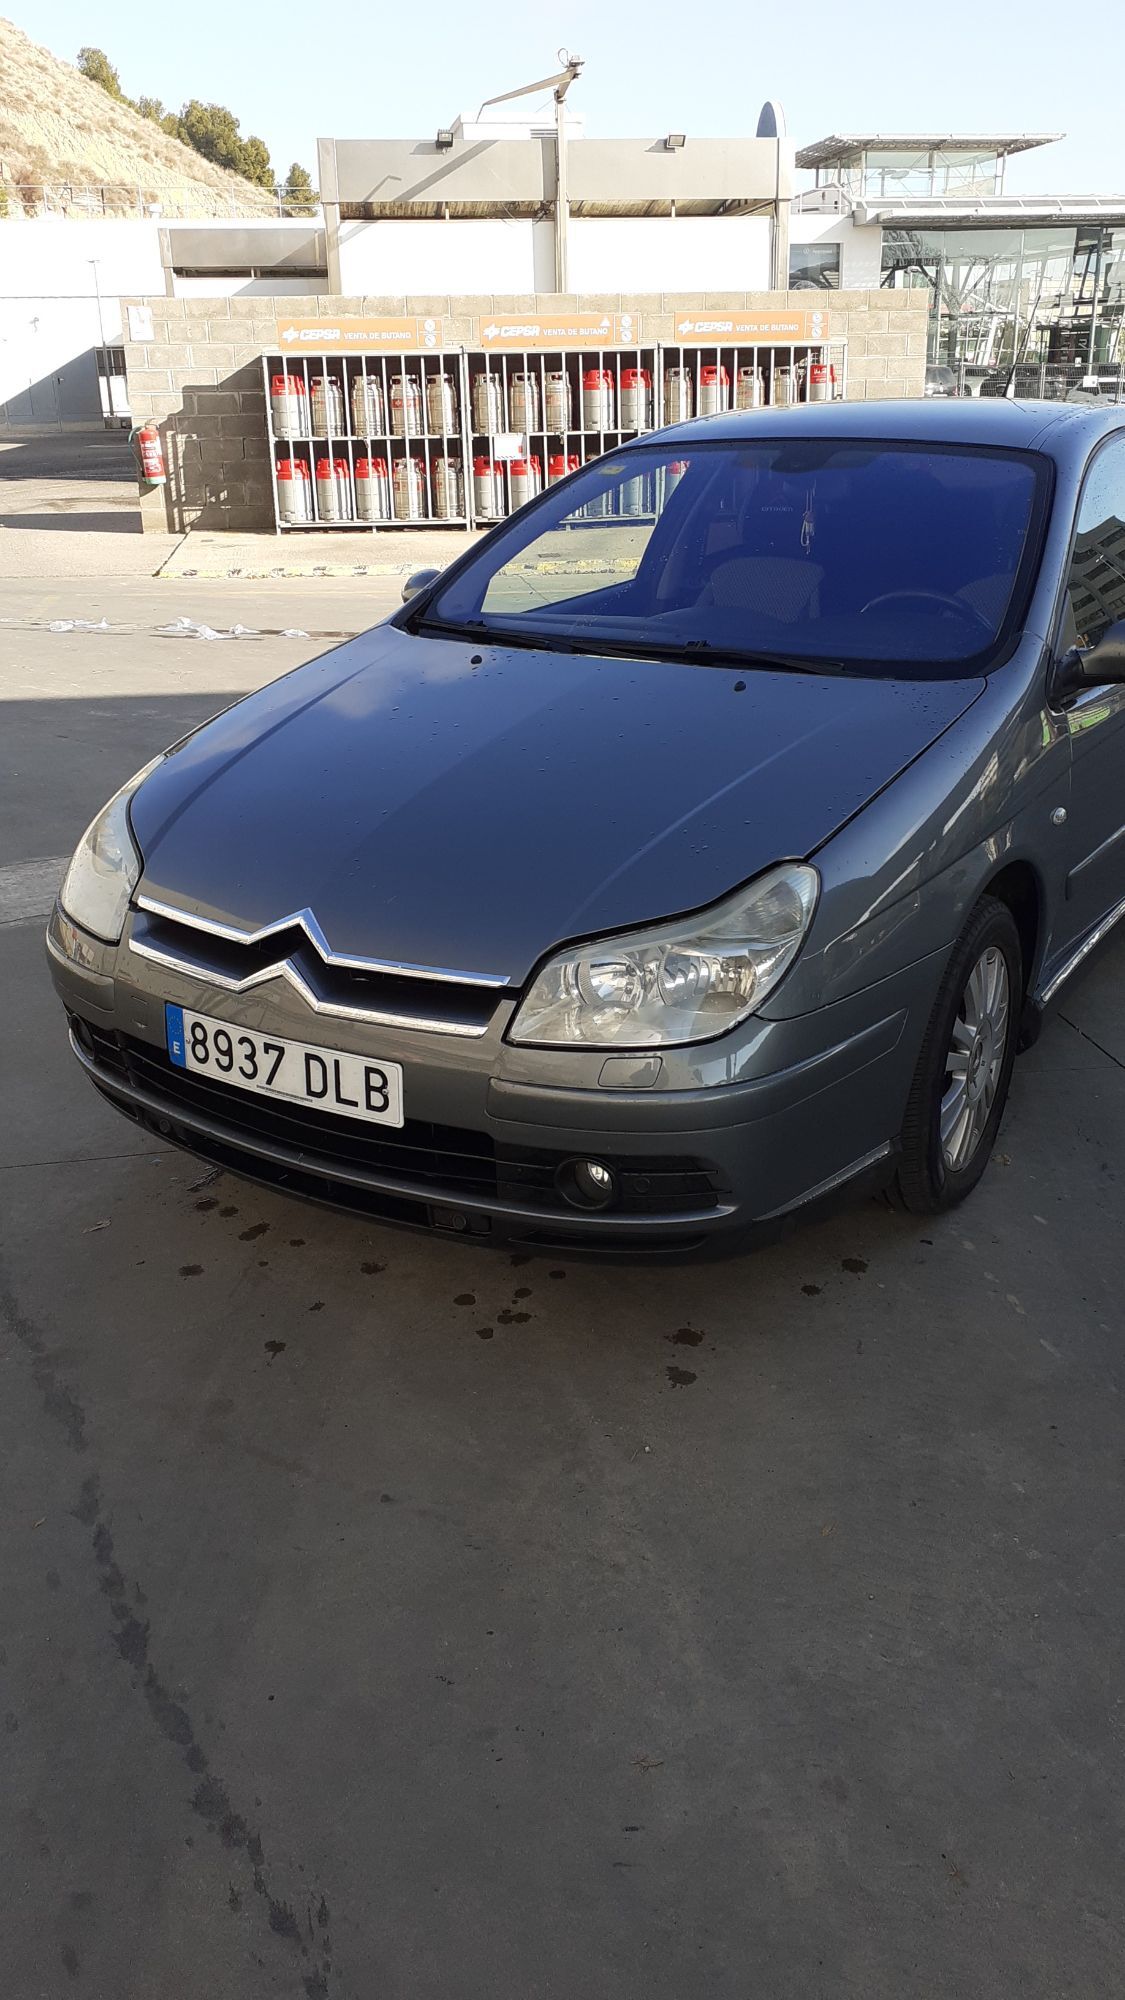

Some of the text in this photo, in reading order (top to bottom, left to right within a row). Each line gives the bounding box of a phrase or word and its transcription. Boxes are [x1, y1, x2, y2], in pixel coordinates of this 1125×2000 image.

[500, 325, 608, 337] CEPSA VENTA DE BUTANO
[694, 321, 799, 333] CEPSA VENTA DE BUTANO
[301, 329, 412, 340] CEPSA VENTA DE BUTANO
[173, 1041, 181, 1055] E
[190, 1021, 390, 1113] 8937 DLB
